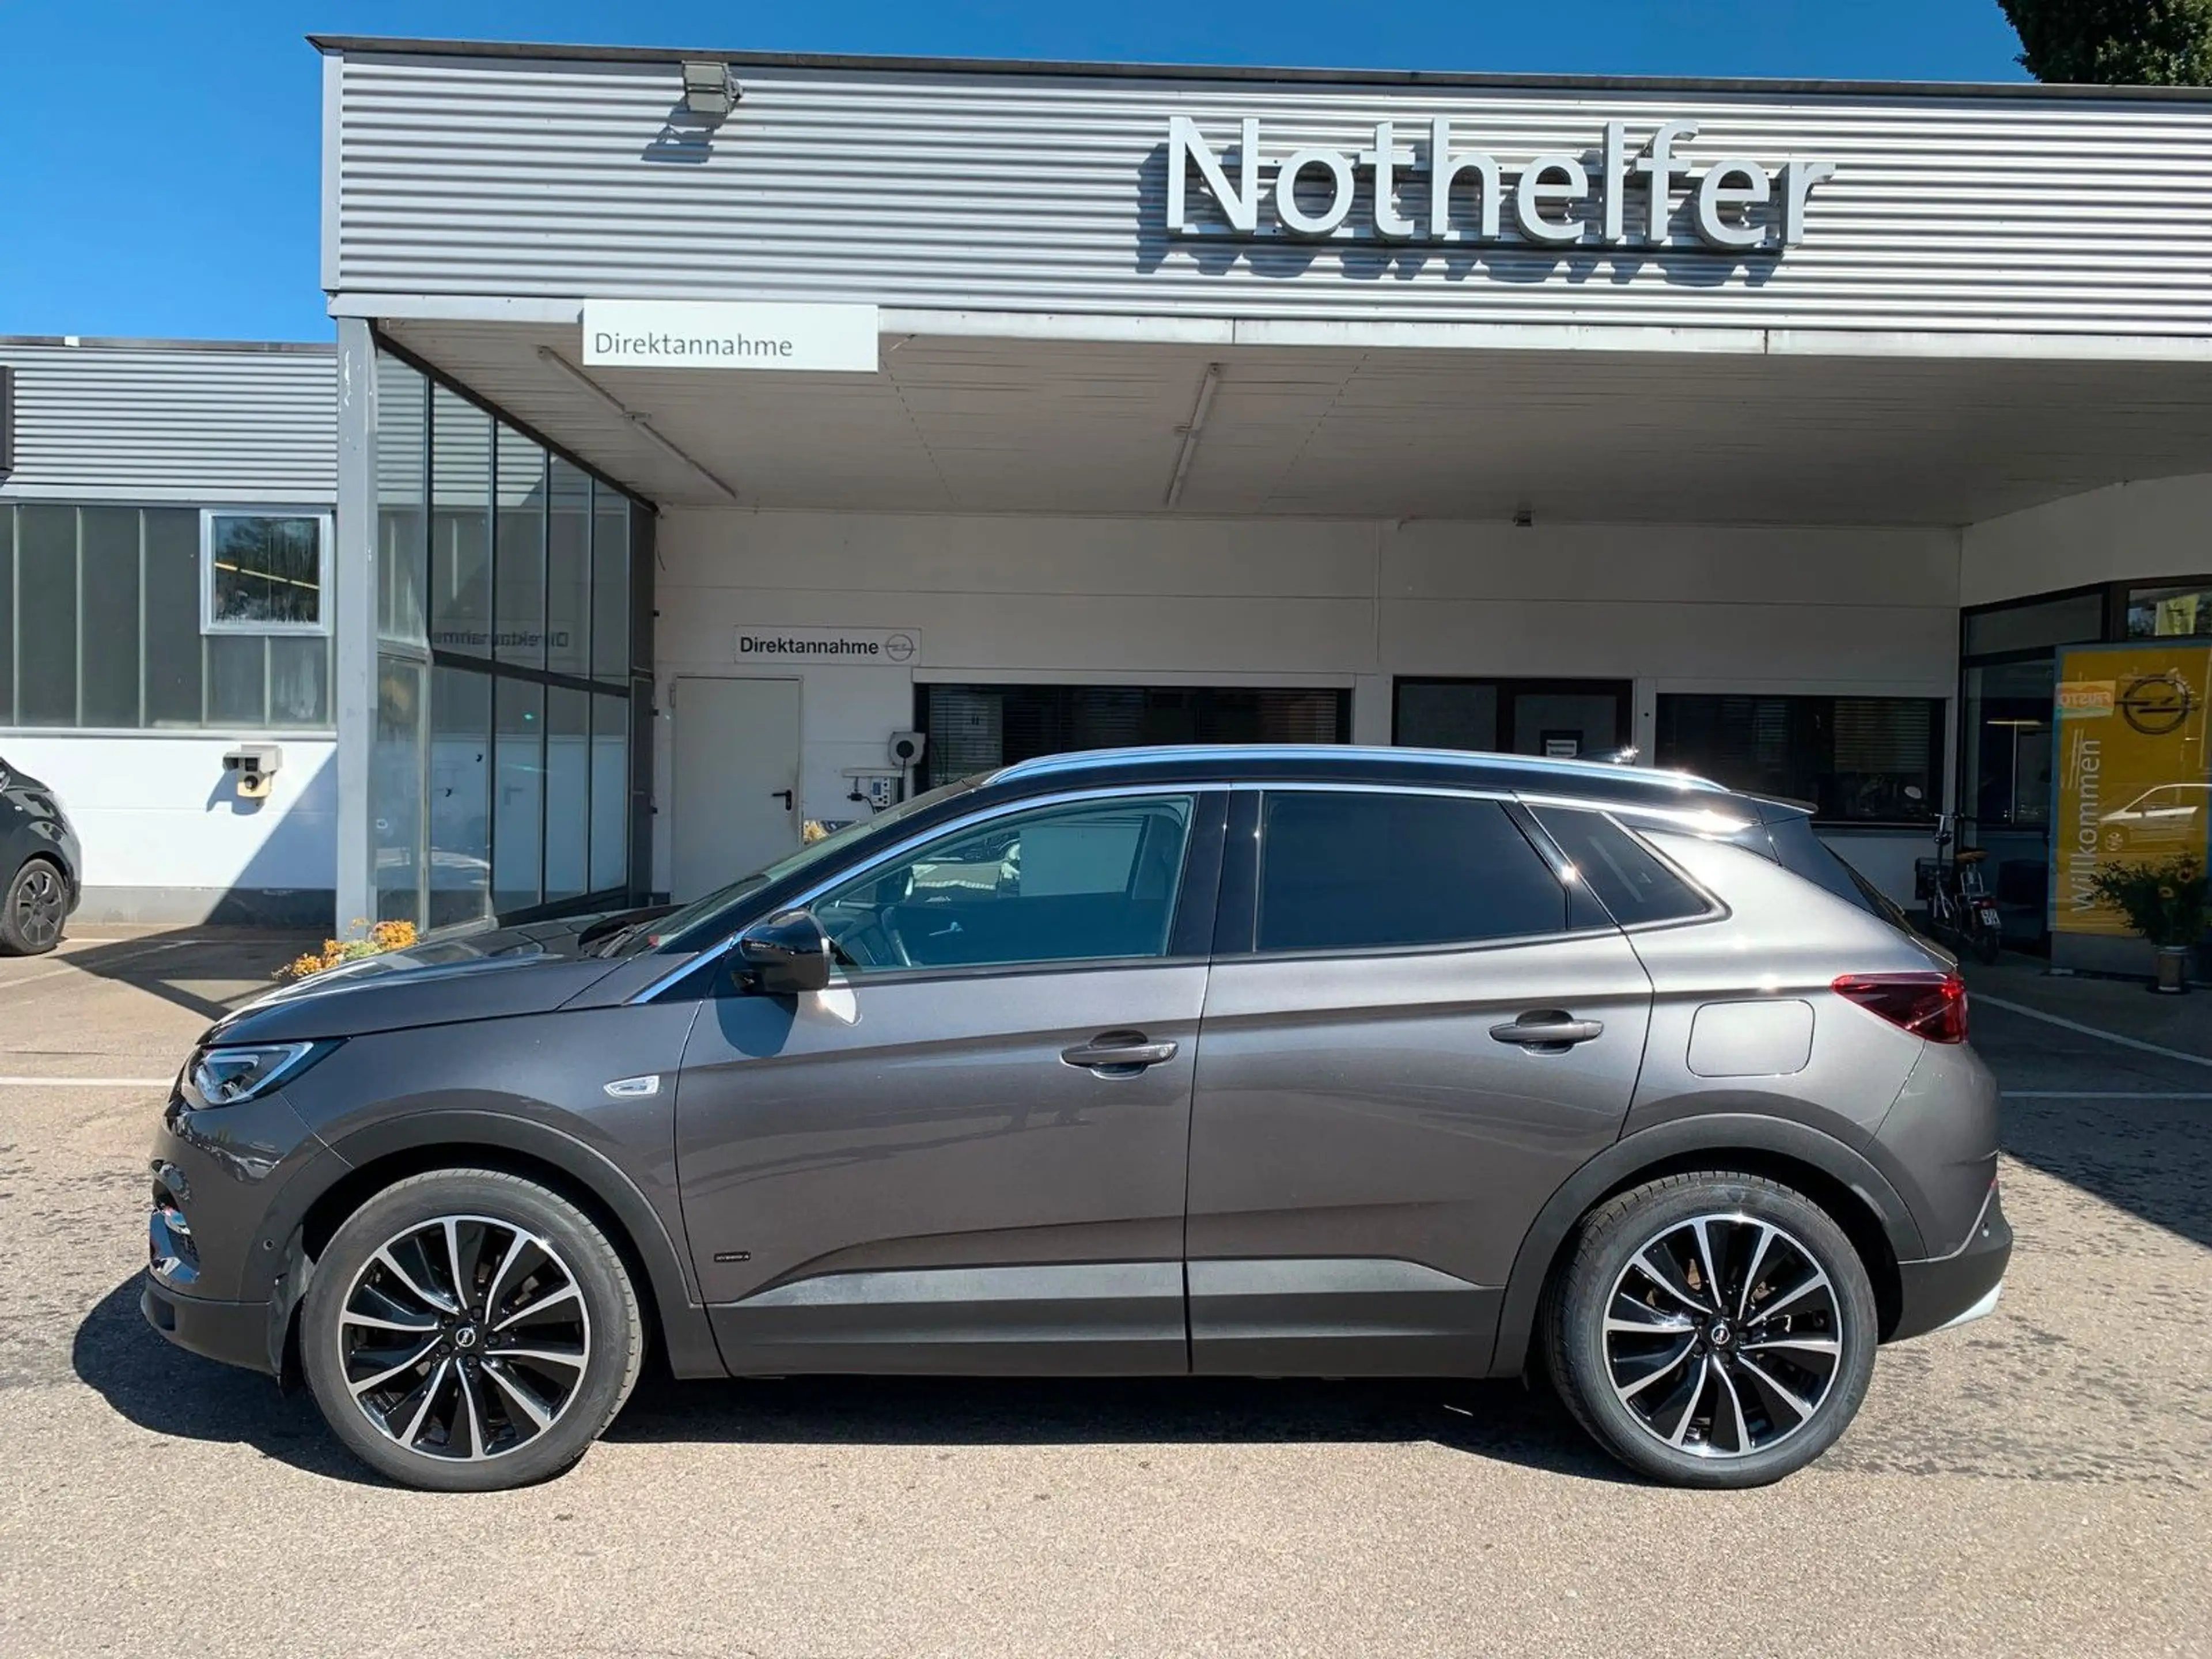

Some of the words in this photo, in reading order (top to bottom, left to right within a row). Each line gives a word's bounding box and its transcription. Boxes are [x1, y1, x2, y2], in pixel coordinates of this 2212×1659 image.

[1166, 116, 1835, 249] Nothelfer
[594, 332, 793, 357] Direktannahme
[740, 636, 880, 656] Direktannahme
[2070, 740, 2101, 912] Willkommen
